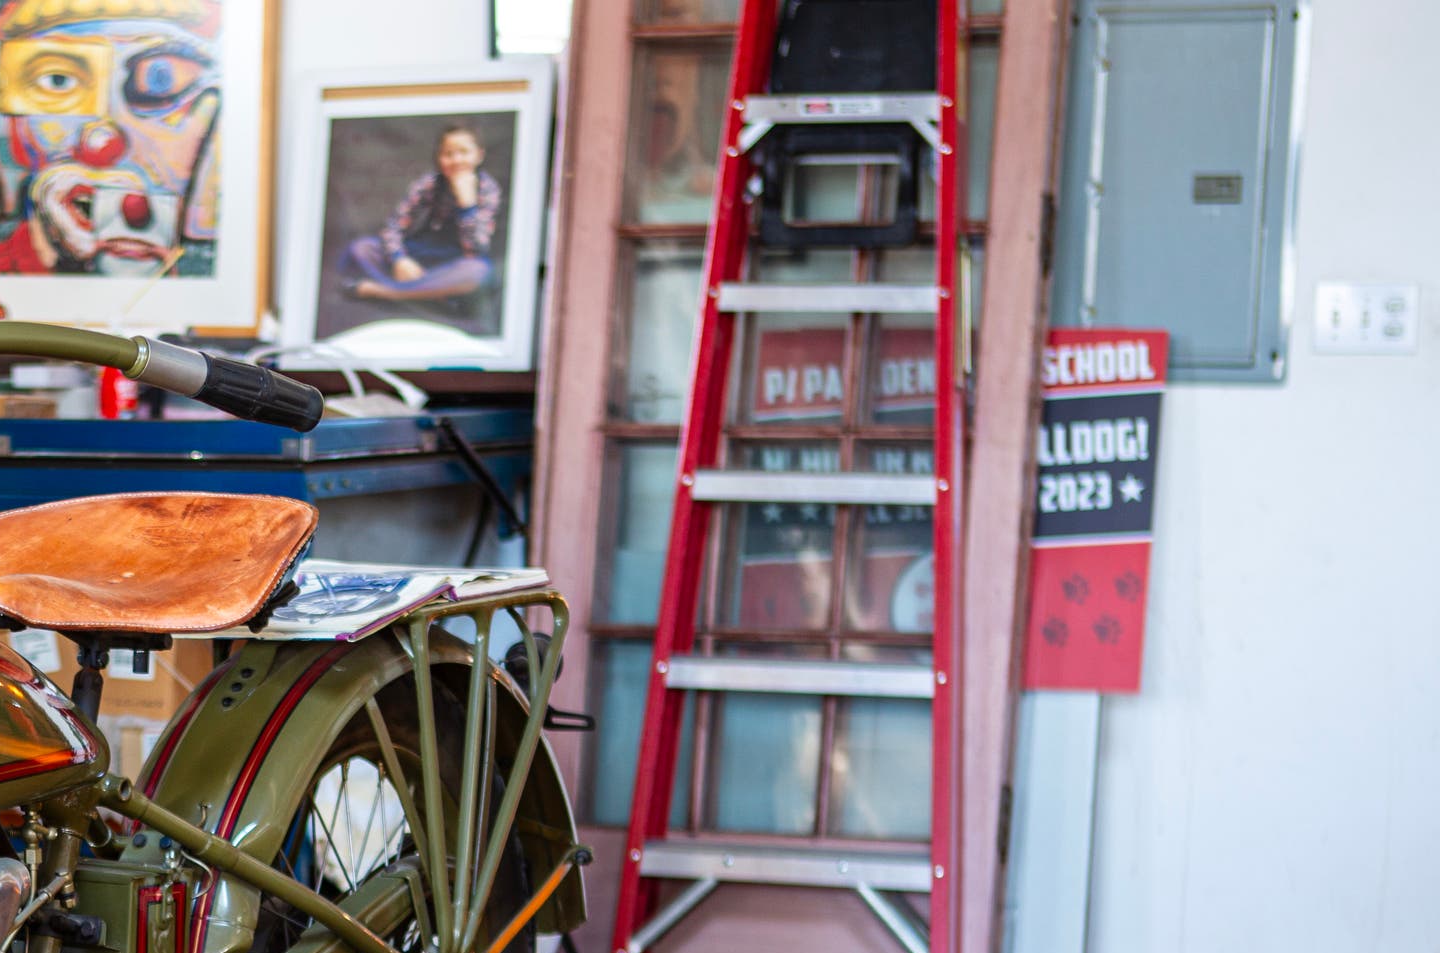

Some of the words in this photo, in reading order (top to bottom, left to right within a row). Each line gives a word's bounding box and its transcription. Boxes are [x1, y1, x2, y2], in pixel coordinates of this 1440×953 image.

[1042, 340, 1155, 384] SCHOOL
[1039, 417, 1150, 467] LLDOG!
[1040, 472, 1112, 512] 2023
